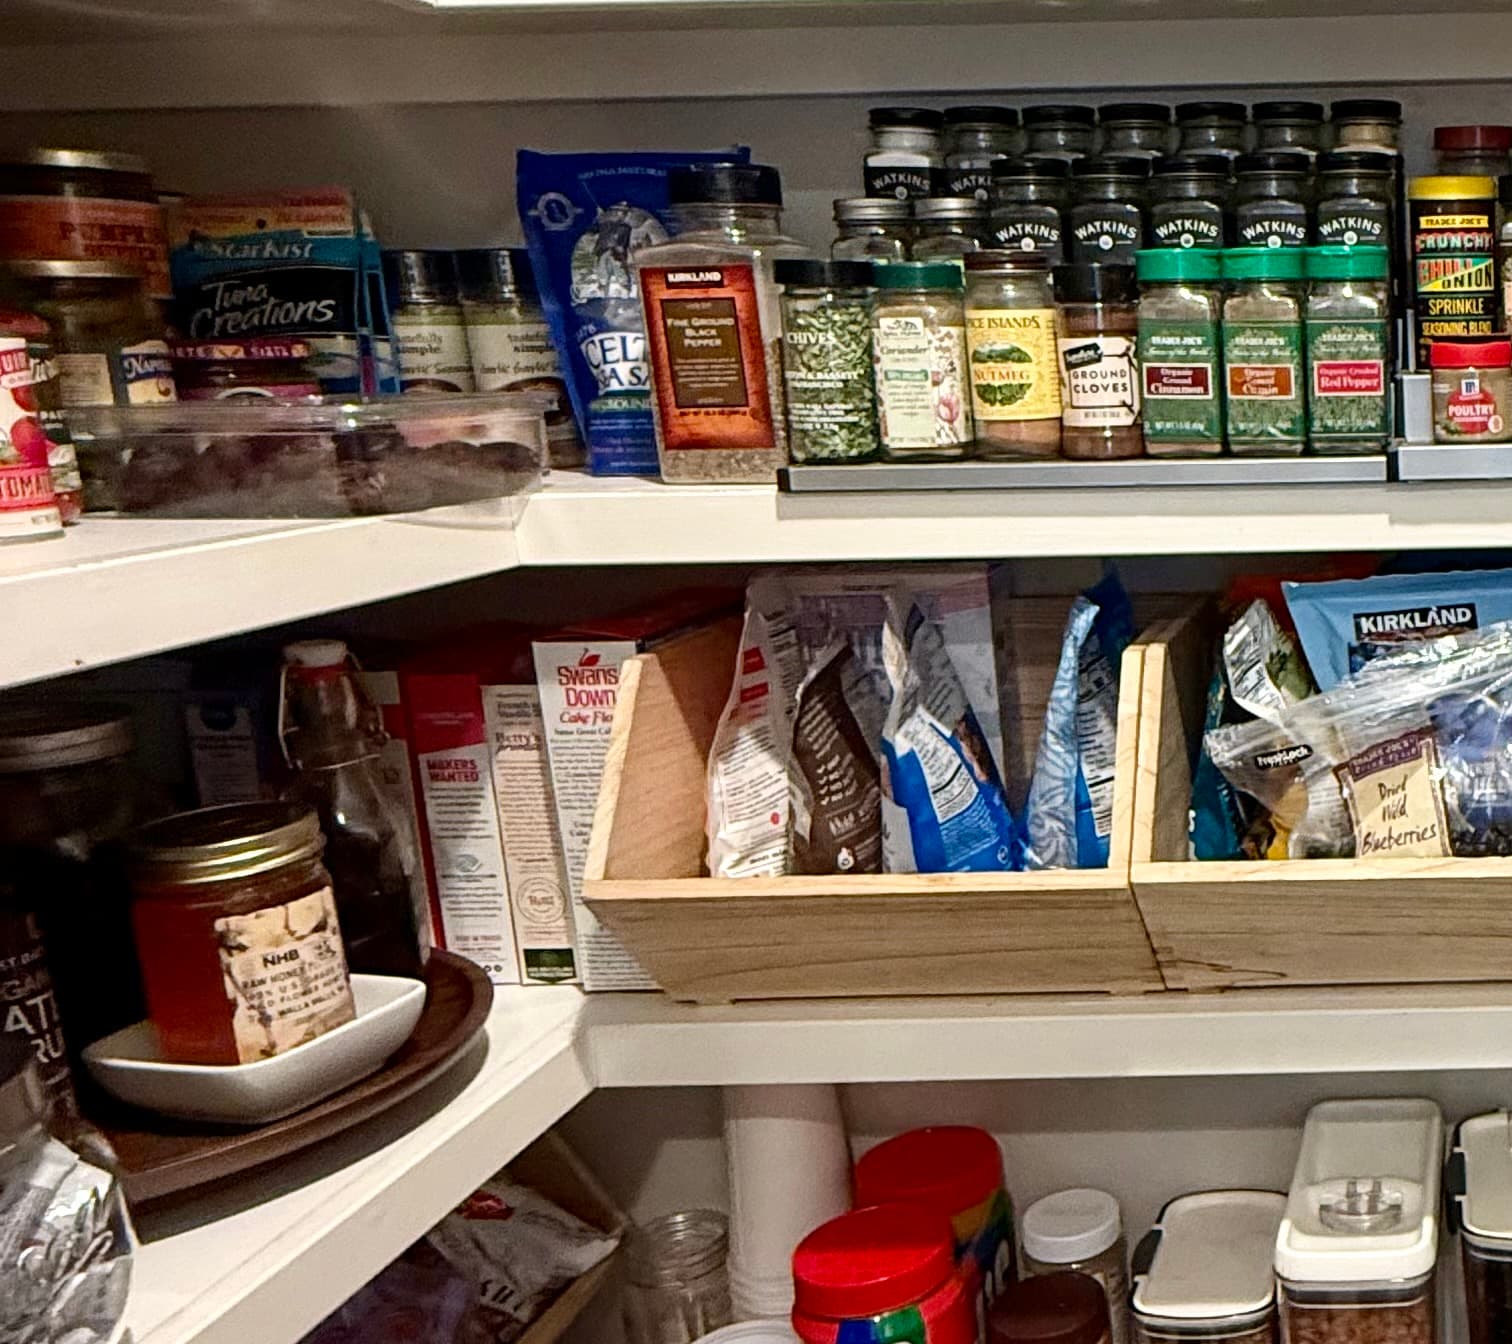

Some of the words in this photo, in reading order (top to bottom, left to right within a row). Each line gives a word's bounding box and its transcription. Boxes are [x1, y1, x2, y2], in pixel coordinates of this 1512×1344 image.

[873, 173, 931, 191] WATKINS
[950, 173, 992, 194] WATKI
[995, 222, 1060, 244] WATKINS
[1074, 220, 1137, 241] WATKINS
[1155, 218, 1219, 240] WATKINS
[1242, 219, 1306, 241] WATKINS
[1319, 216, 1383, 236] WATKINS
[667, 271, 722, 284] KIRKLAND
[201, 279, 269, 312] Tuna
[1428, 297, 1484, 315] SPRINKLE
[190, 298, 337, 340] Creations
[987, 316, 1041, 329] ISLANDS
[786, 331, 837, 346] CHIVES
[974, 369, 1030, 382] NUTMEG
[1072, 369, 1128, 380] GROUND
[1320, 375, 1342, 389] Red
[1342, 375, 1380, 390] Pepper
[1072, 382, 1129, 394] CLOVES
[1150, 384, 1204, 396] Cinnamon
[1448, 403, 1496, 417] POULTRY
[1359, 607, 1473, 634] KIRKLAND
[559, 712, 590, 724] Cake
[591, 712, 613, 726] Flo
[428, 770, 479, 782] WANTED
[1361, 822, 1437, 856] Blueberries
[262, 947, 300, 968] NHB
